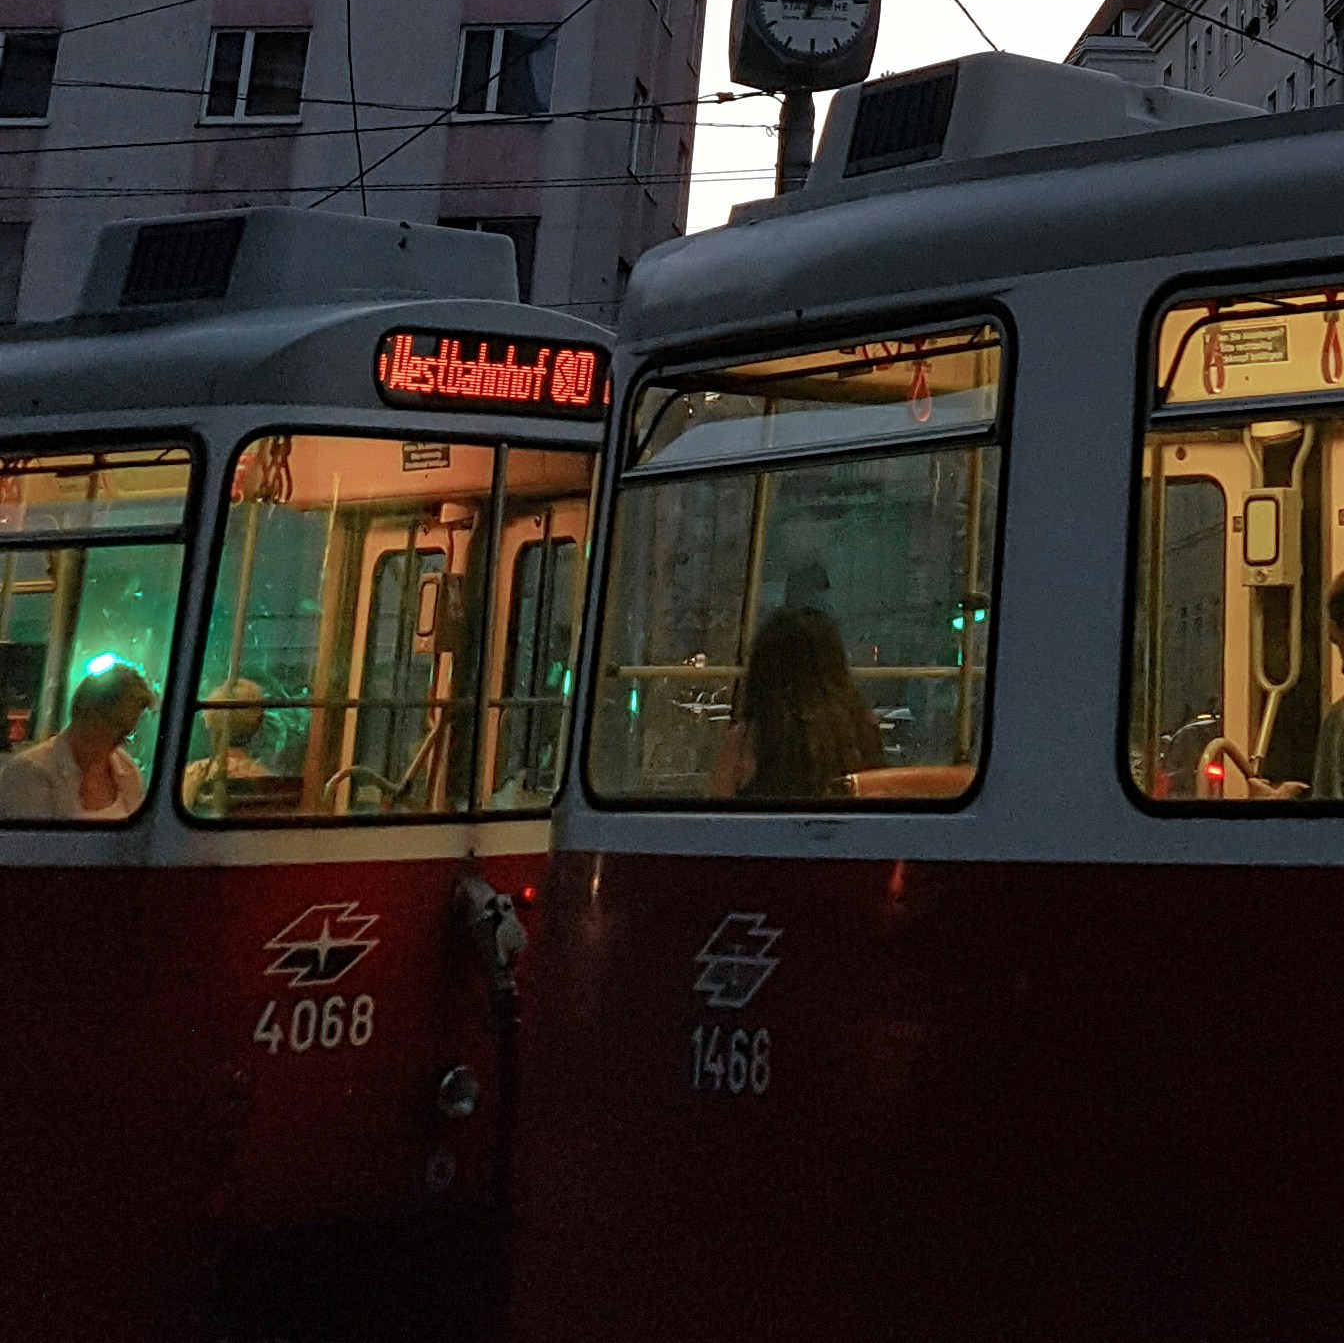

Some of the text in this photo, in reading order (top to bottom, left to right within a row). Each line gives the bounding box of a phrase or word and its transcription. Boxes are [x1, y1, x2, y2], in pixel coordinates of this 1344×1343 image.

[389, 334, 550, 402] Westbahnhof
[253, 993, 375, 1055] 4068
[691, 1024, 772, 1095] 1468
